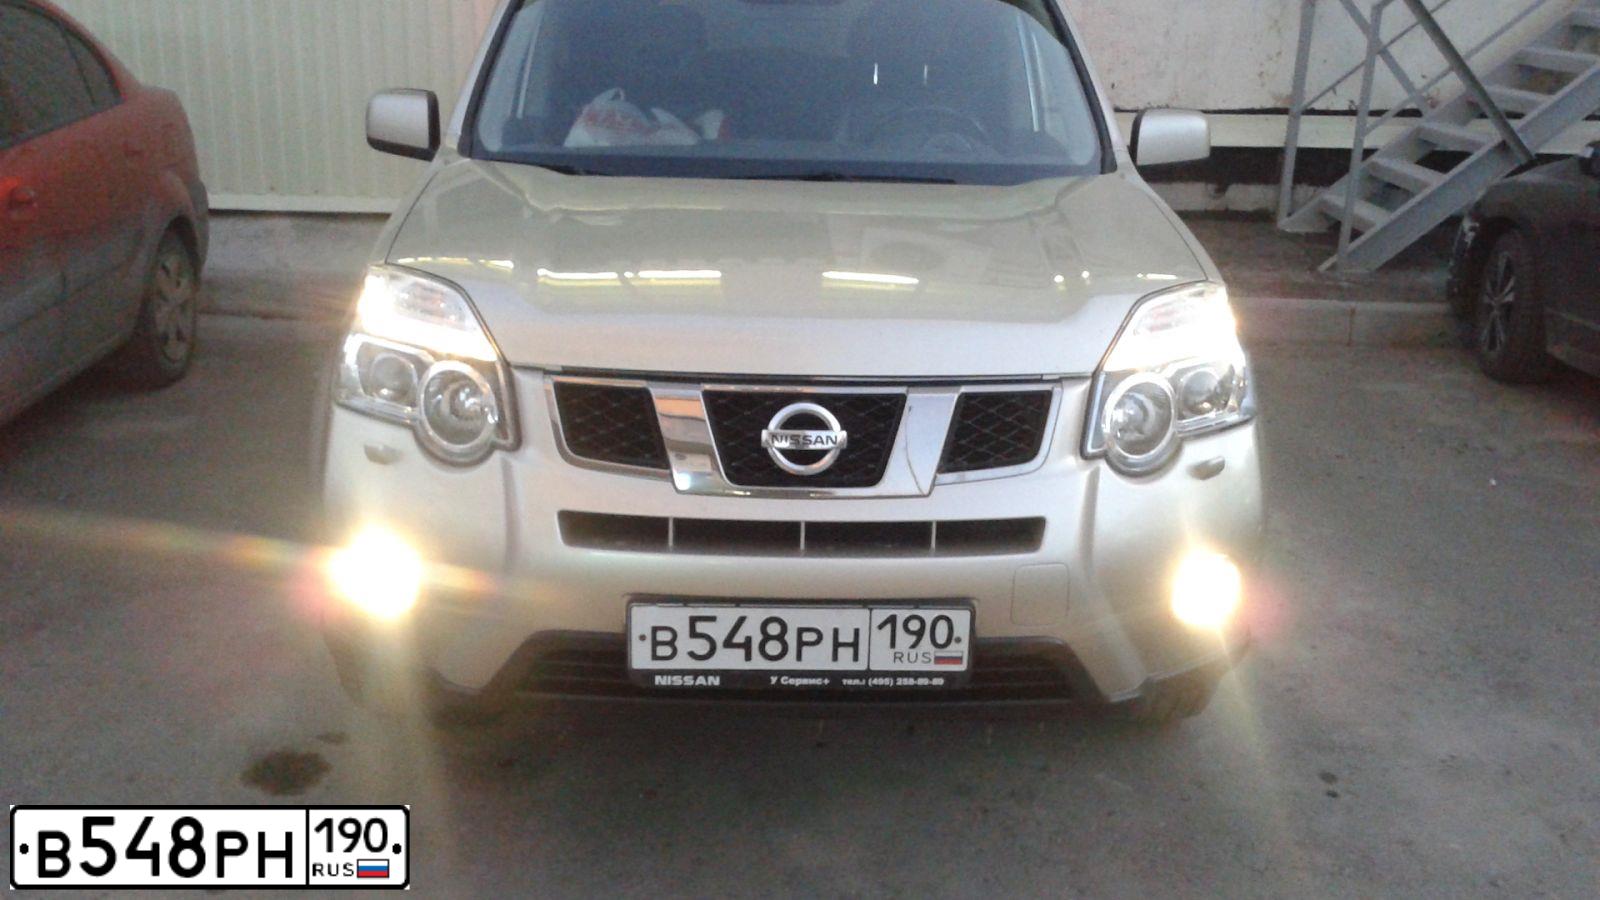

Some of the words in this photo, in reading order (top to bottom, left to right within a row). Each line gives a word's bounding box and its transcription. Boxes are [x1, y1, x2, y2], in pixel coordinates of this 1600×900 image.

[771, 434, 838, 446] NISSAN
[877, 614, 955, 650] 190
[893, 651, 932, 665] RUS
[654, 675, 721, 686] NISSAN
